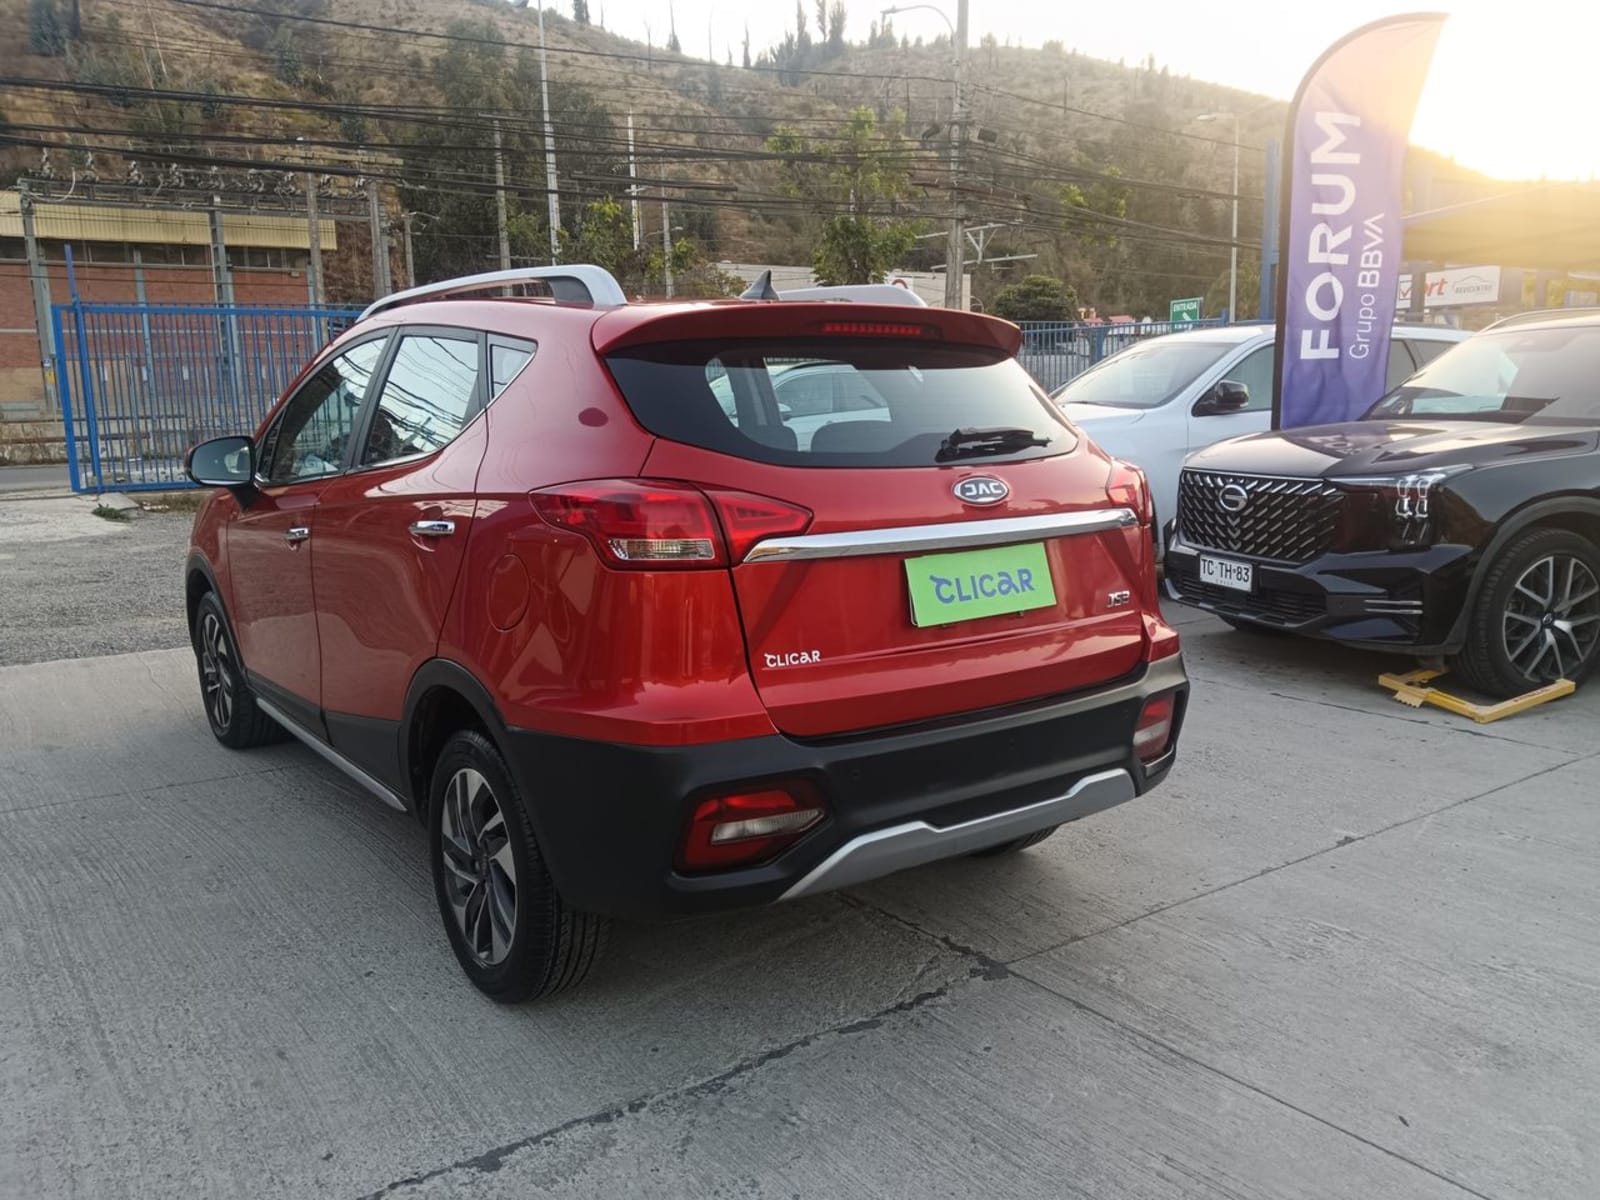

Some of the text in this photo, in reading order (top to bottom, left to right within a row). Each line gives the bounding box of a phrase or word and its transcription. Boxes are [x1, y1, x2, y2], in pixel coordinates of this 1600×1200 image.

[1300, 111, 1361, 360] FORUM
[1349, 213, 1385, 360] Grupo BBVA
[964, 482, 1003, 496] JAC
